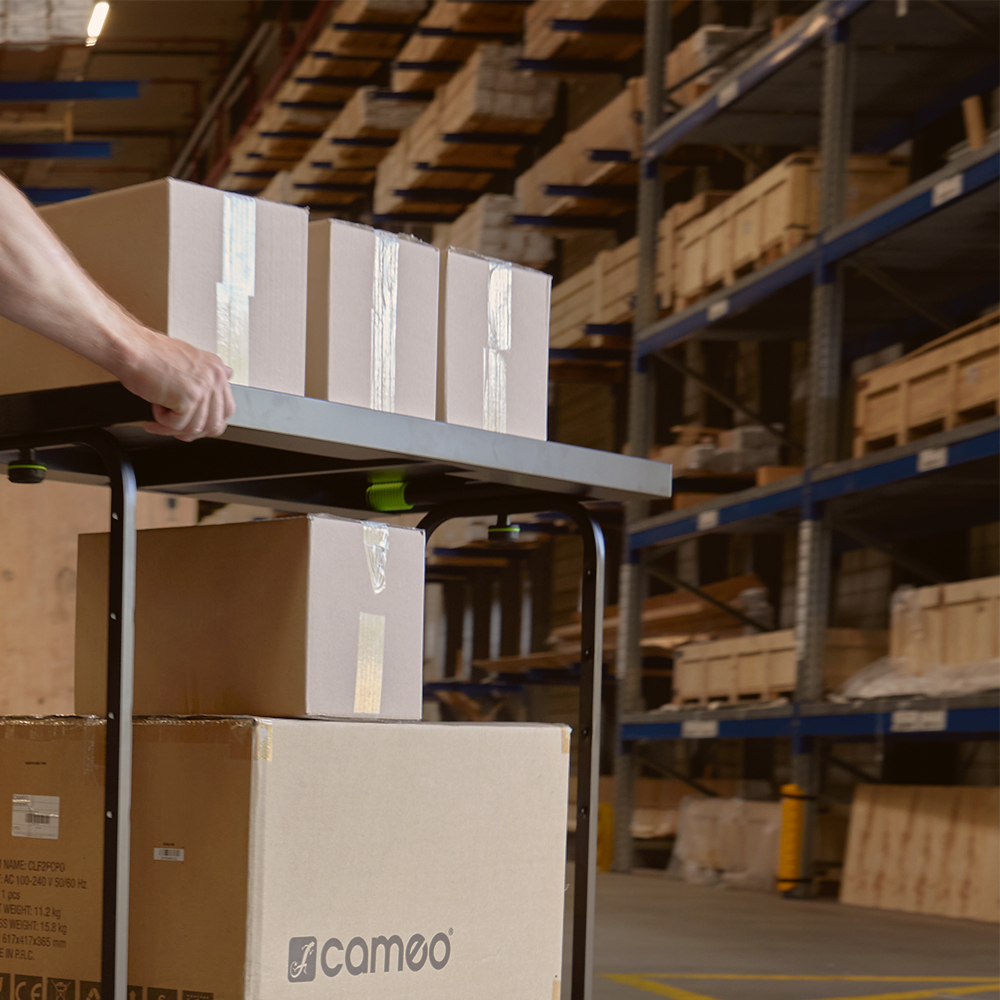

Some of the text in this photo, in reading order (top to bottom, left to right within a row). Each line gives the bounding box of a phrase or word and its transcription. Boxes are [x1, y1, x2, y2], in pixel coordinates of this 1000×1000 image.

[4, 859, 26, 870] NAME:
[4, 875, 14, 884] AC
[16, 876, 46, 886] 100-240
[48, 877, 52, 886] V
[55, 878, 76, 888] 50/60
[78, 879, 87, 889] Hz
[2, 890, 5, 898] 1
[8, 892, 20, 900] pcs
[4, 904, 32, 915] WEIGHT:
[34, 906, 50, 917] 11.2
[52, 907, 61, 920] kg
[10, 919, 39, 931] WEIGHT:
[41, 922, 56, 932] 15.8
[58, 923, 67, 935] kg
[2, 934, 50, 947] 617x417x365
[52, 940, 66, 948] mm
[6, 949, 13, 958] IN
[15, 949, 35, 960] P.R.C.
